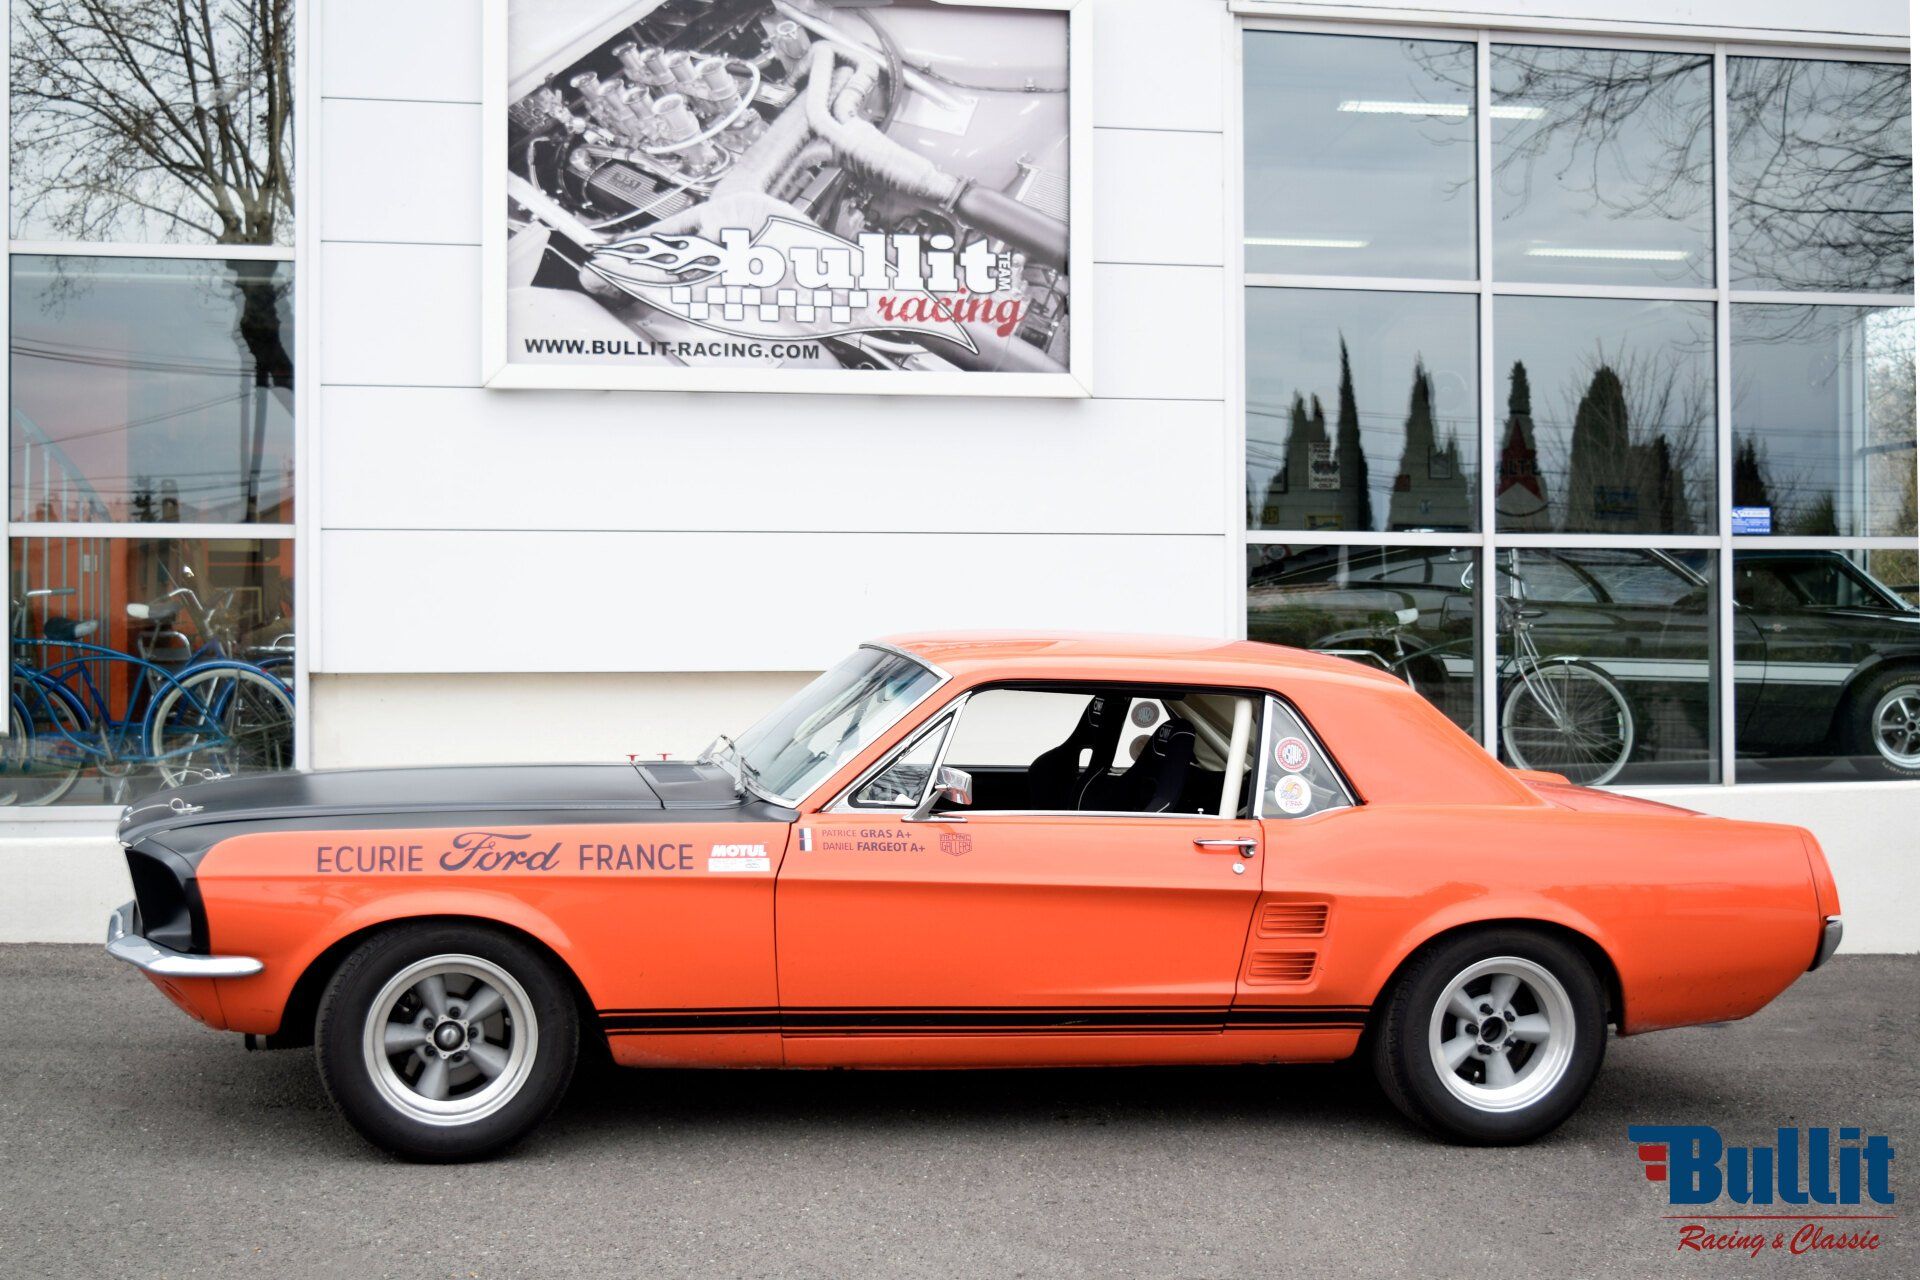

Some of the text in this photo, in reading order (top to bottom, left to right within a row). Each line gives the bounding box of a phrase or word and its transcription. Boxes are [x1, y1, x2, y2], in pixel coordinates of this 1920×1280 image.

[721, 228, 997, 294] bullit
[998, 251, 1012, 291] TEAM
[877, 288, 1025, 337] racing
[524, 338, 820, 359] WWW.BULLIT-RACING.COM
[821, 829, 912, 838] PATRICE GRAS A+
[823, 842, 926, 852] DANIEL FARGEOT A+
[317, 845, 424, 873] ECURIE
[439, 832, 562, 871] Ford
[579, 843, 694, 871] FRANCE
[711, 844, 767, 857] MOTUL
